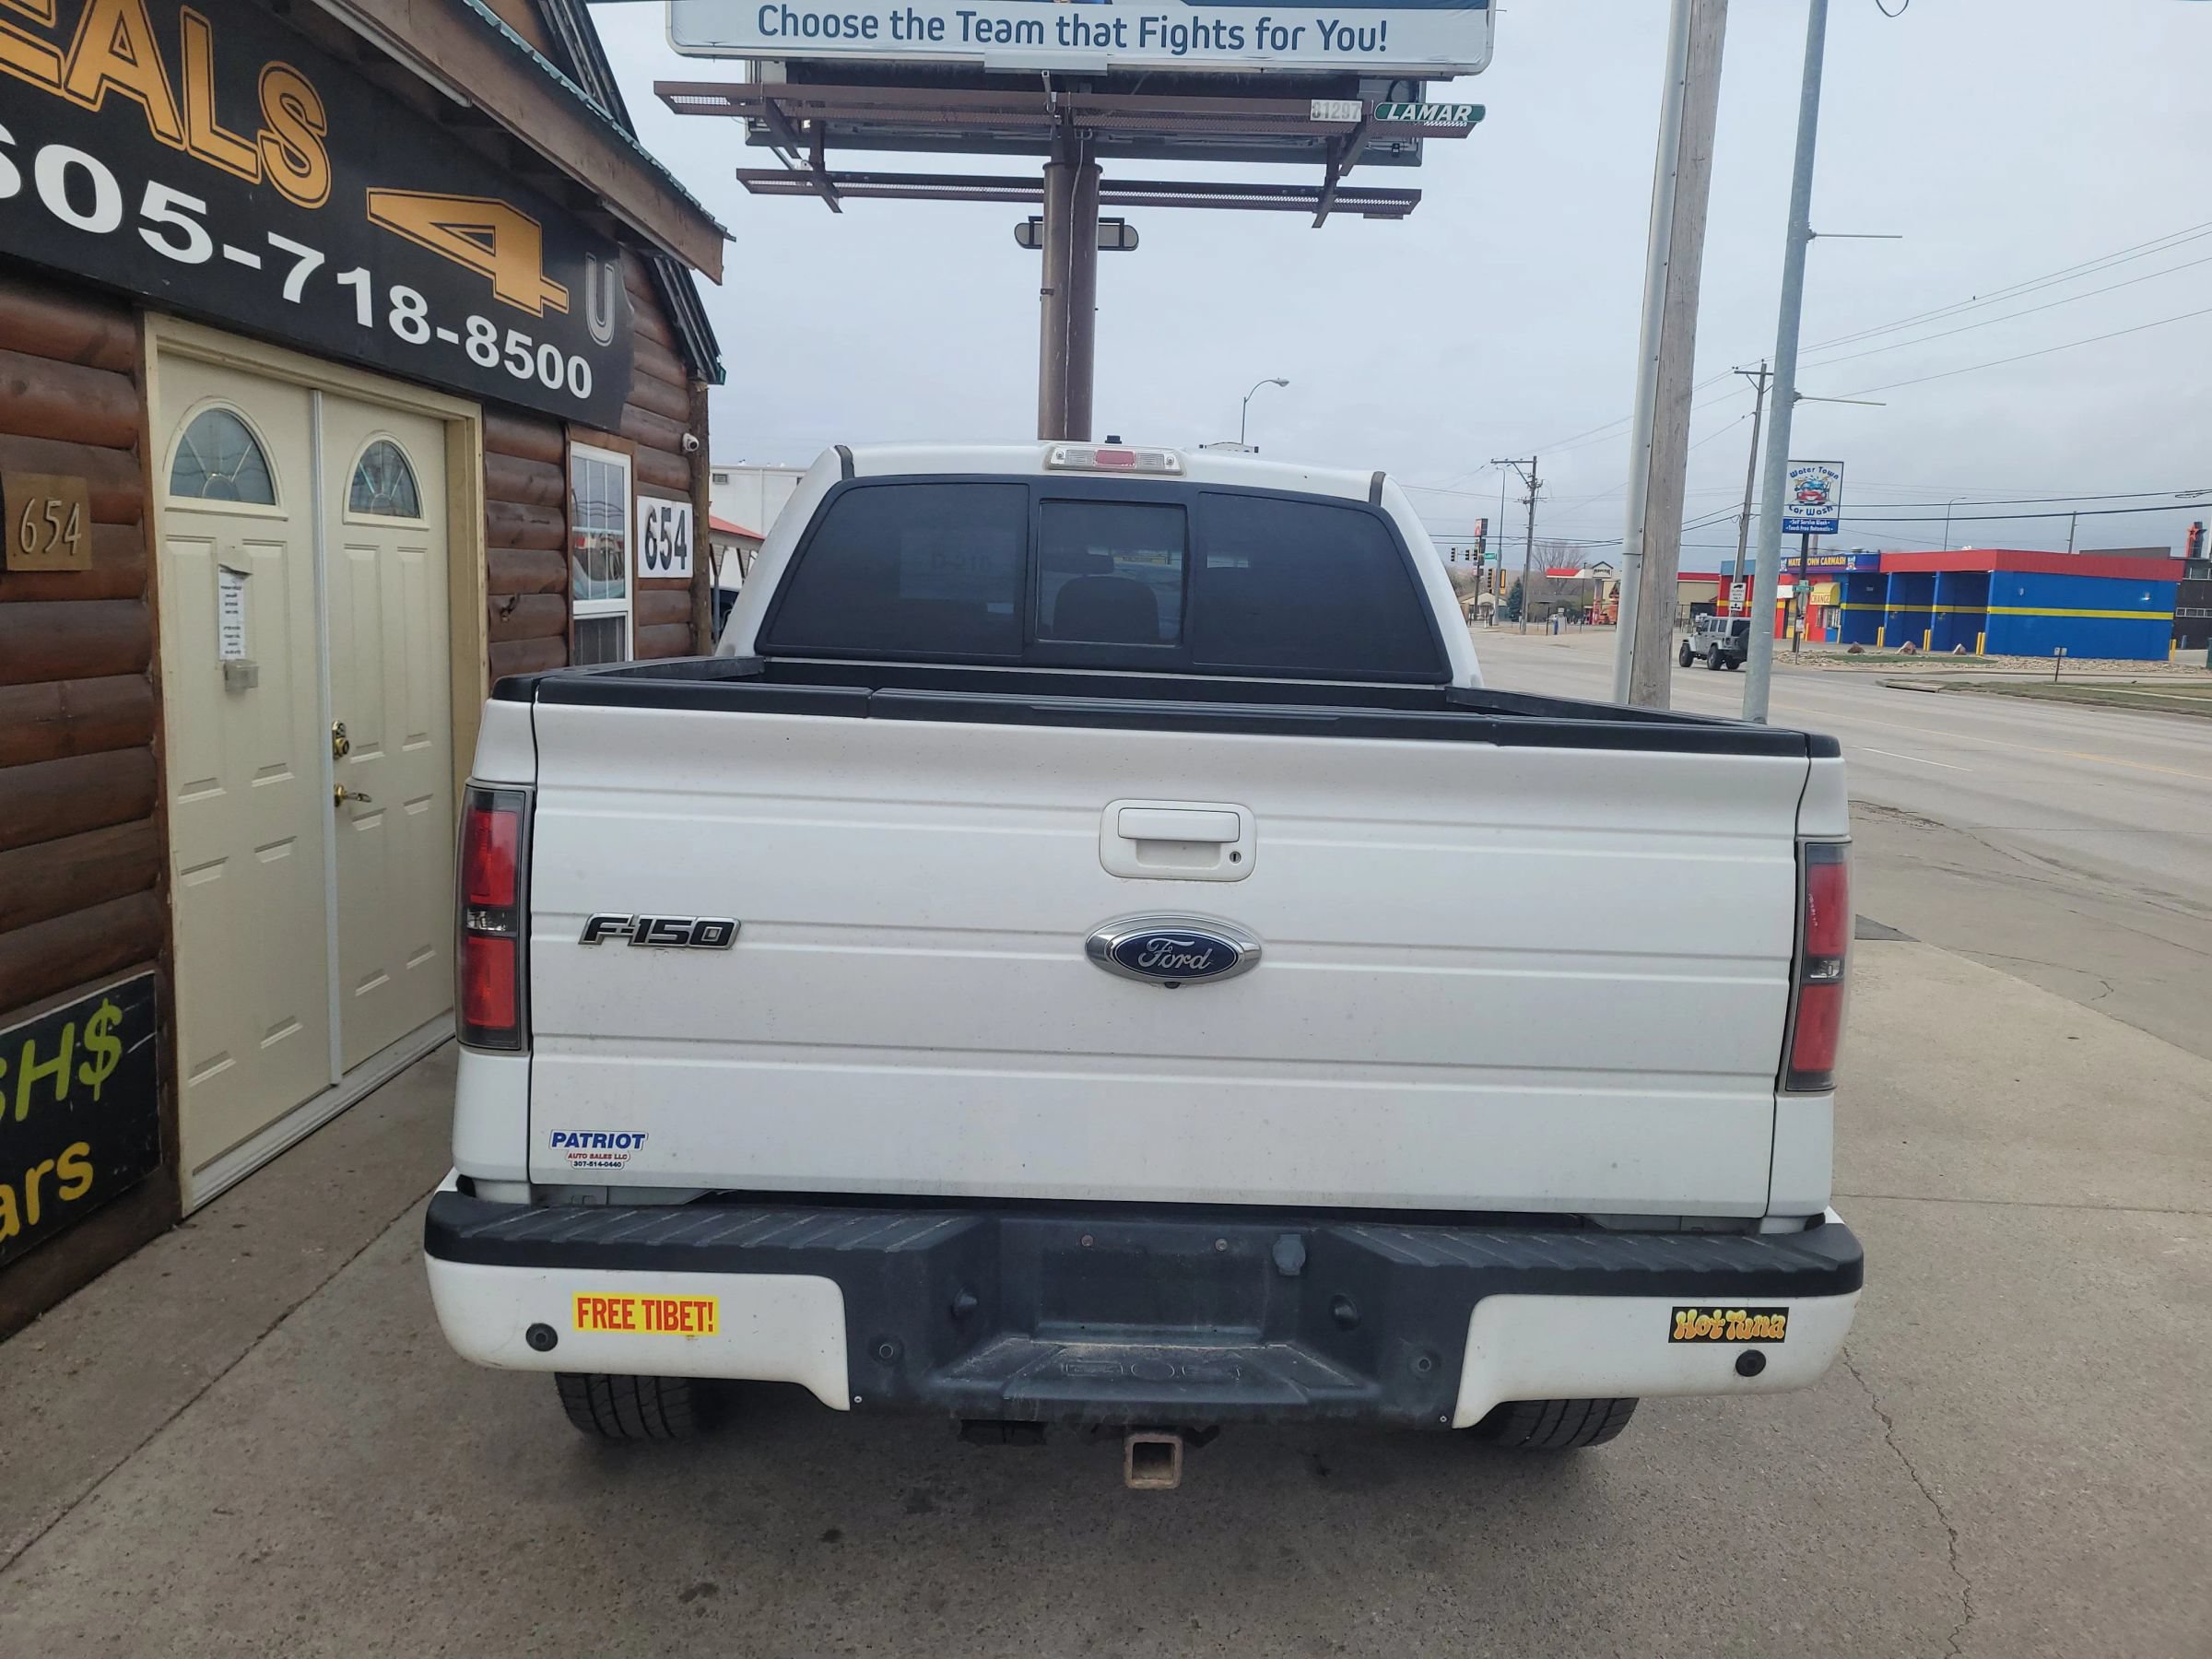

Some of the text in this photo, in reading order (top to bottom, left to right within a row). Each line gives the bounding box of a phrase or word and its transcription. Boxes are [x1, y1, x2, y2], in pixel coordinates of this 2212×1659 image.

[758, 5, 1387, 56] Choose the Team that Fights for You!
[1312, 102, 1361, 120] 31297
[1386, 104, 1474, 121] LAMAR
[0, 123, 593, 400] 05-718-8500
[366, 186, 570, 318] 4
[585, 252, 616, 347] U
[20, 498, 82, 556] 654
[645, 505, 688, 571] 654
[579, 912, 741, 950] F-150
[1137, 937, 1214, 971] Ford
[551, 1132, 645, 1149] PATRIOT
[577, 1298, 713, 1332] FREE TIBET!
[1674, 1309, 1785, 1340] Hot Tuna
